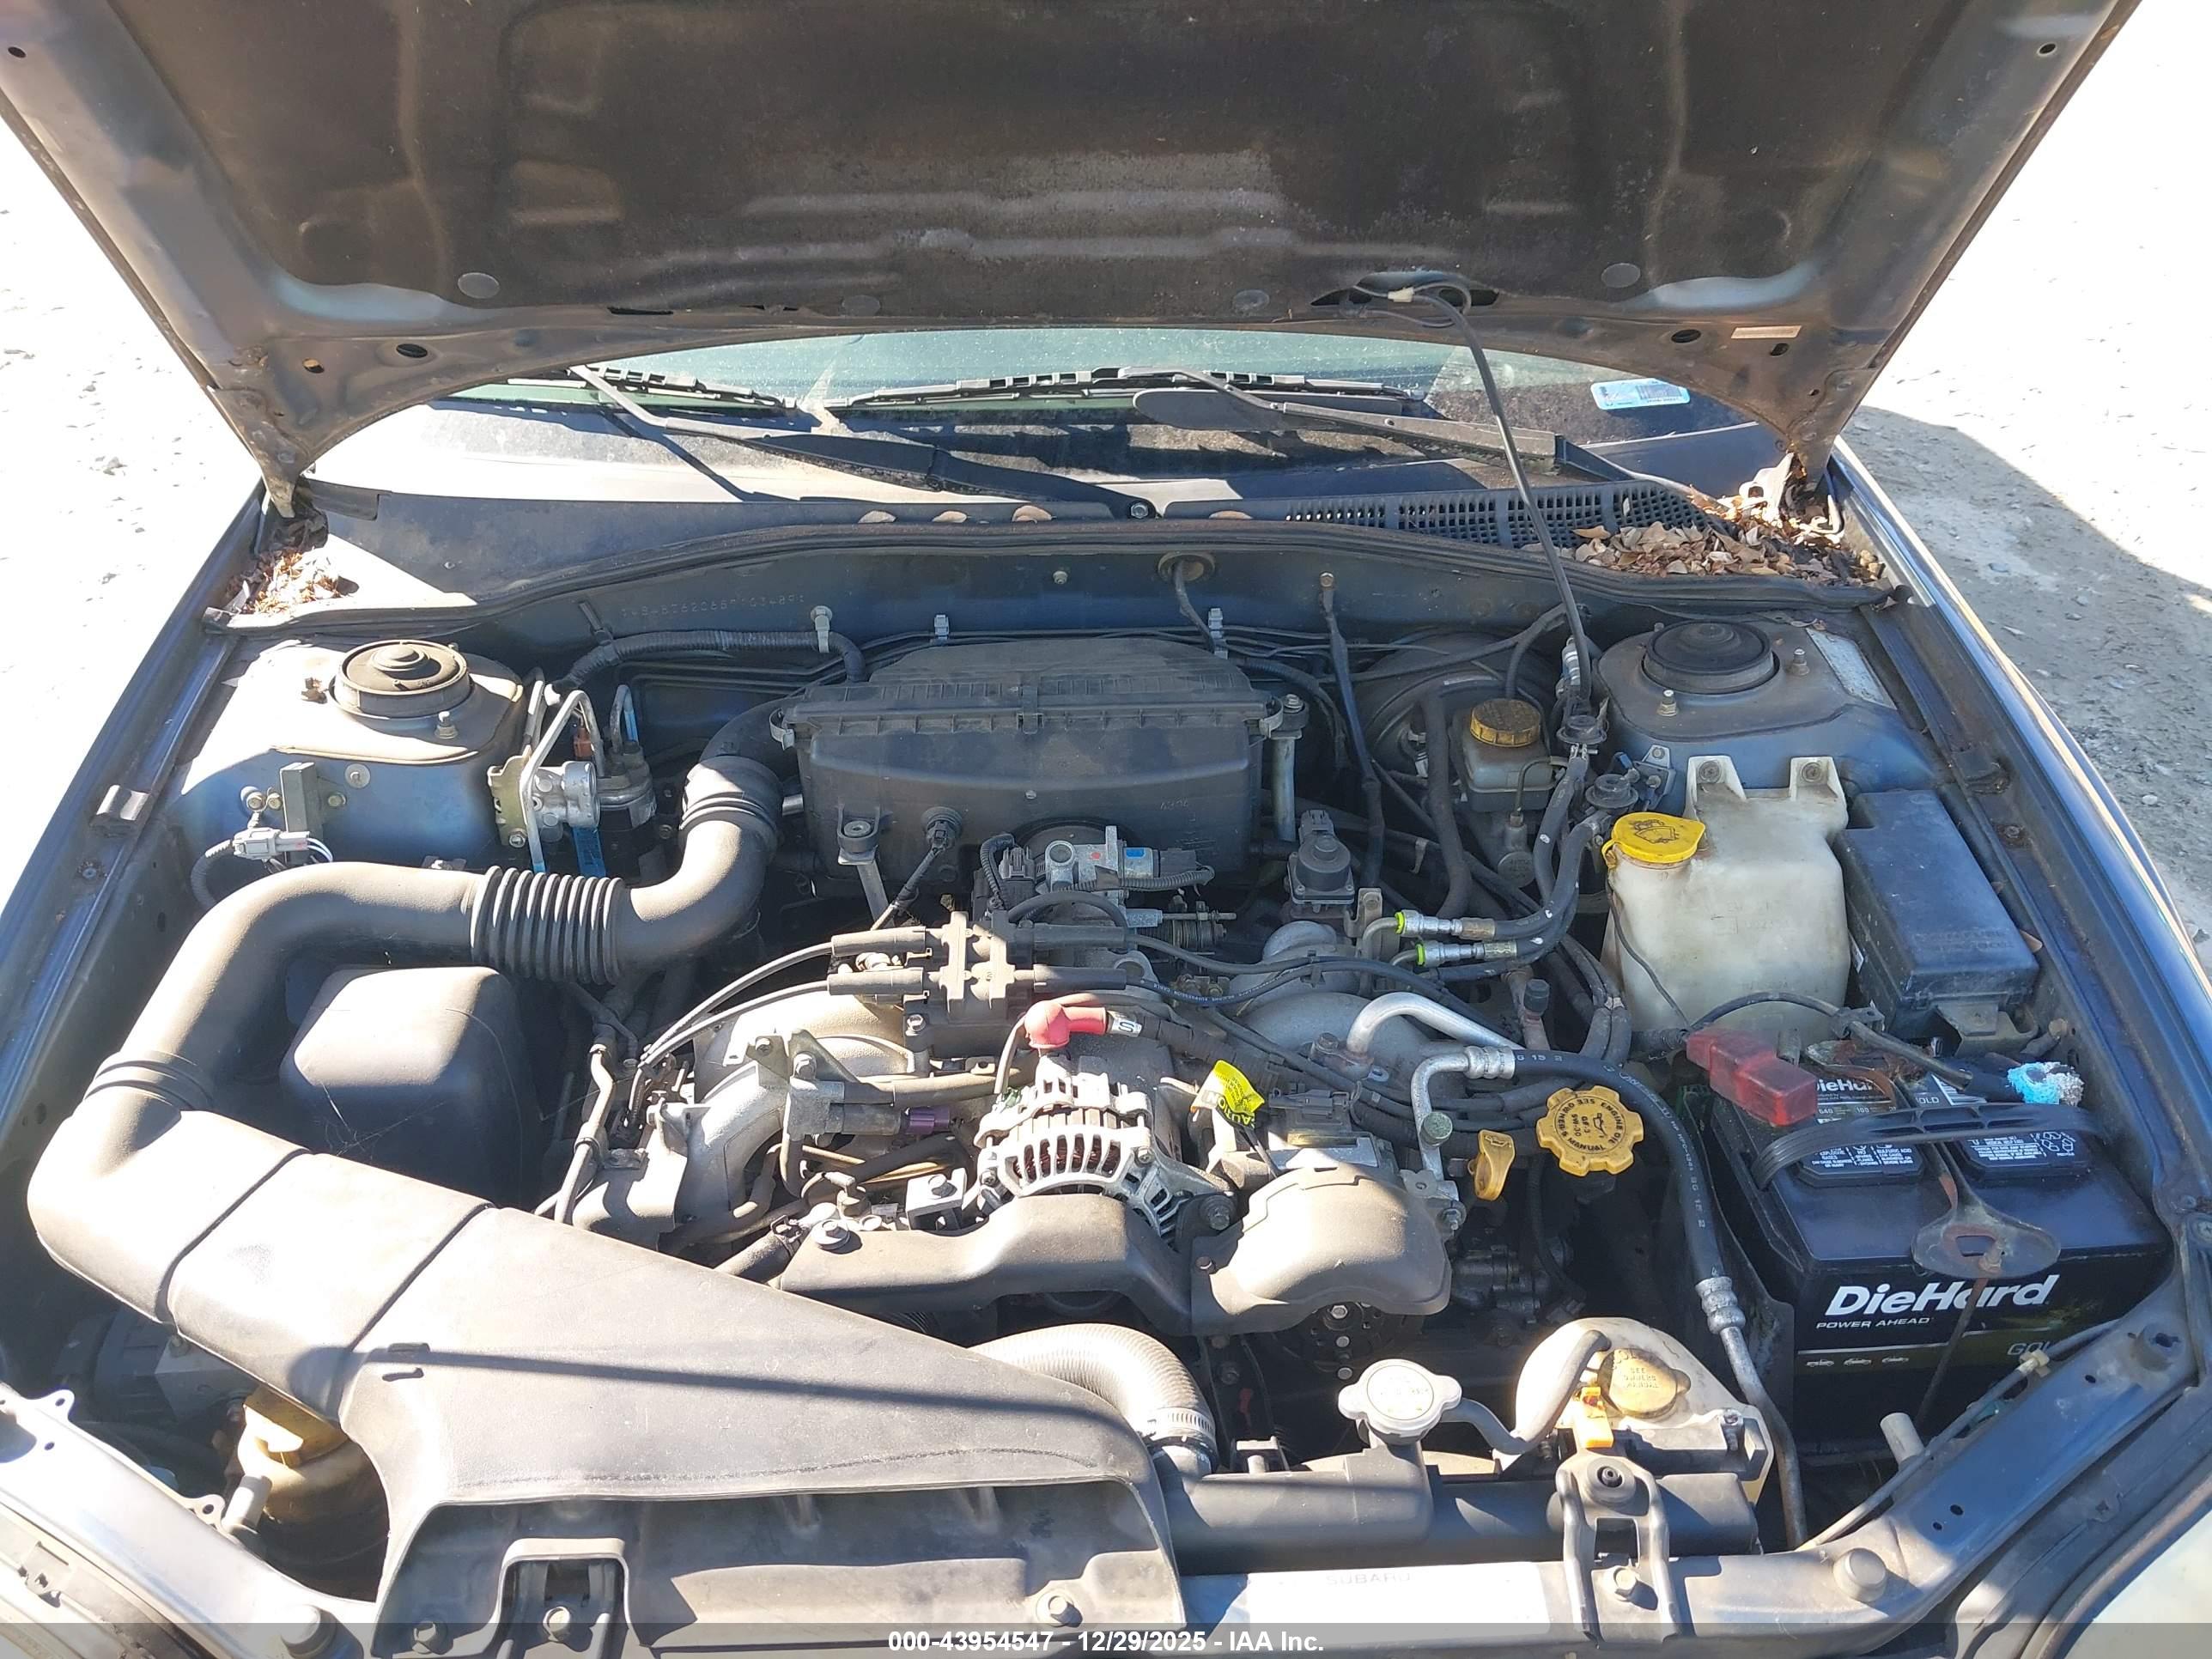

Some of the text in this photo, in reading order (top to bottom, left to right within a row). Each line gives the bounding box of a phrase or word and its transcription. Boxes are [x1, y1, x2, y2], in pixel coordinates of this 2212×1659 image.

[1600, 1102, 1624, 1145] ENGINE OIL
[1567, 1137, 1607, 1152] MANUAL
[1825, 1274, 2059, 1316] DieHard
[1816, 1317, 1930, 1329] POWER AHEAD
